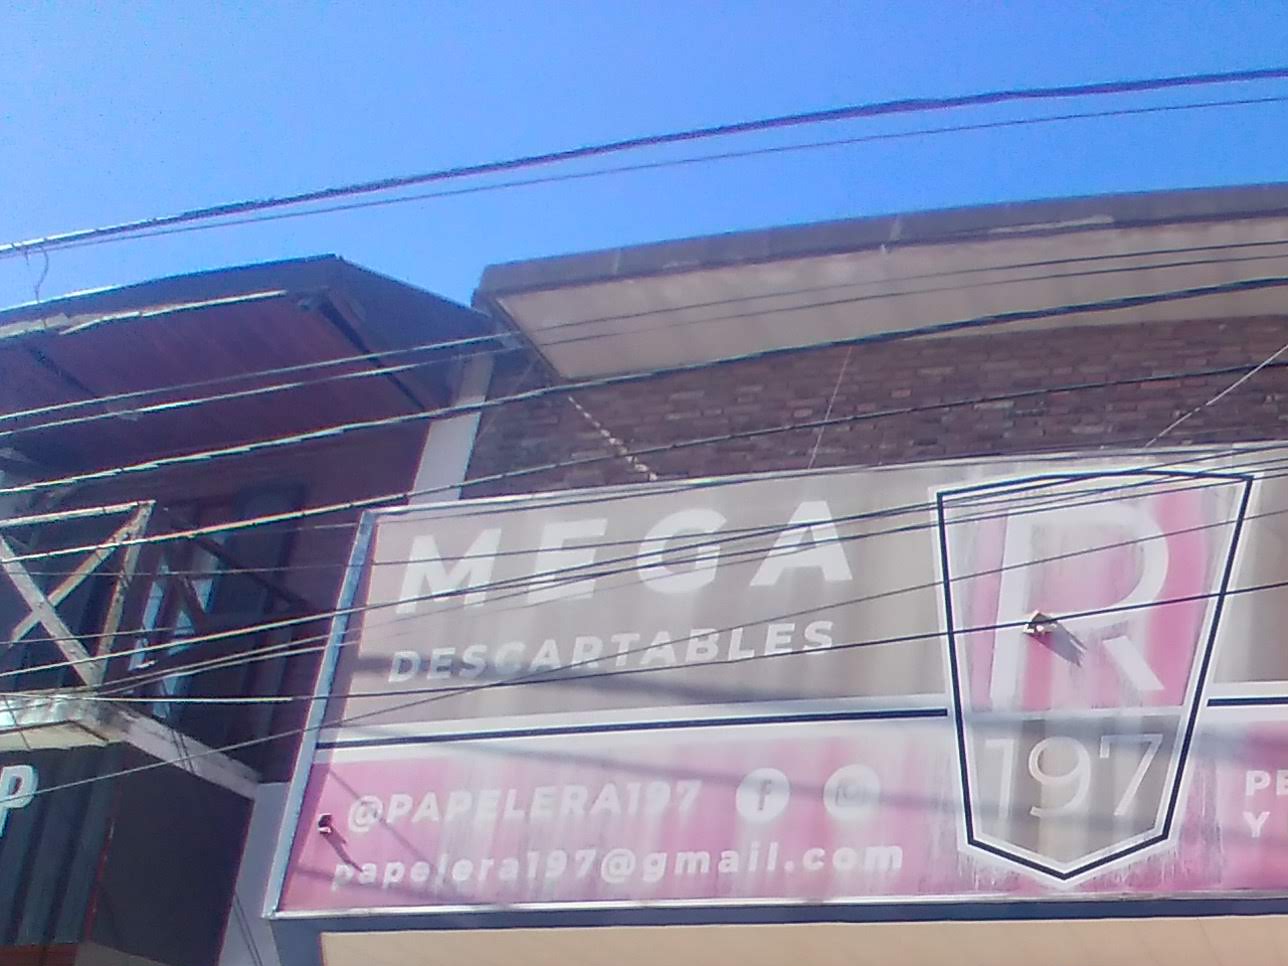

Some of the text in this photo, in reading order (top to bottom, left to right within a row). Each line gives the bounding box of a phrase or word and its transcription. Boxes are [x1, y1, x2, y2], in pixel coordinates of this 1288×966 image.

[394, 499, 854, 615] MEGA
[988, 500, 1172, 703] R
[387, 617, 838, 685] DESCARTABLES
[347, 778, 703, 833] @PAPELERA197
[983, 732, 1164, 820] 197
[1242, 809, 1272, 840] Y
